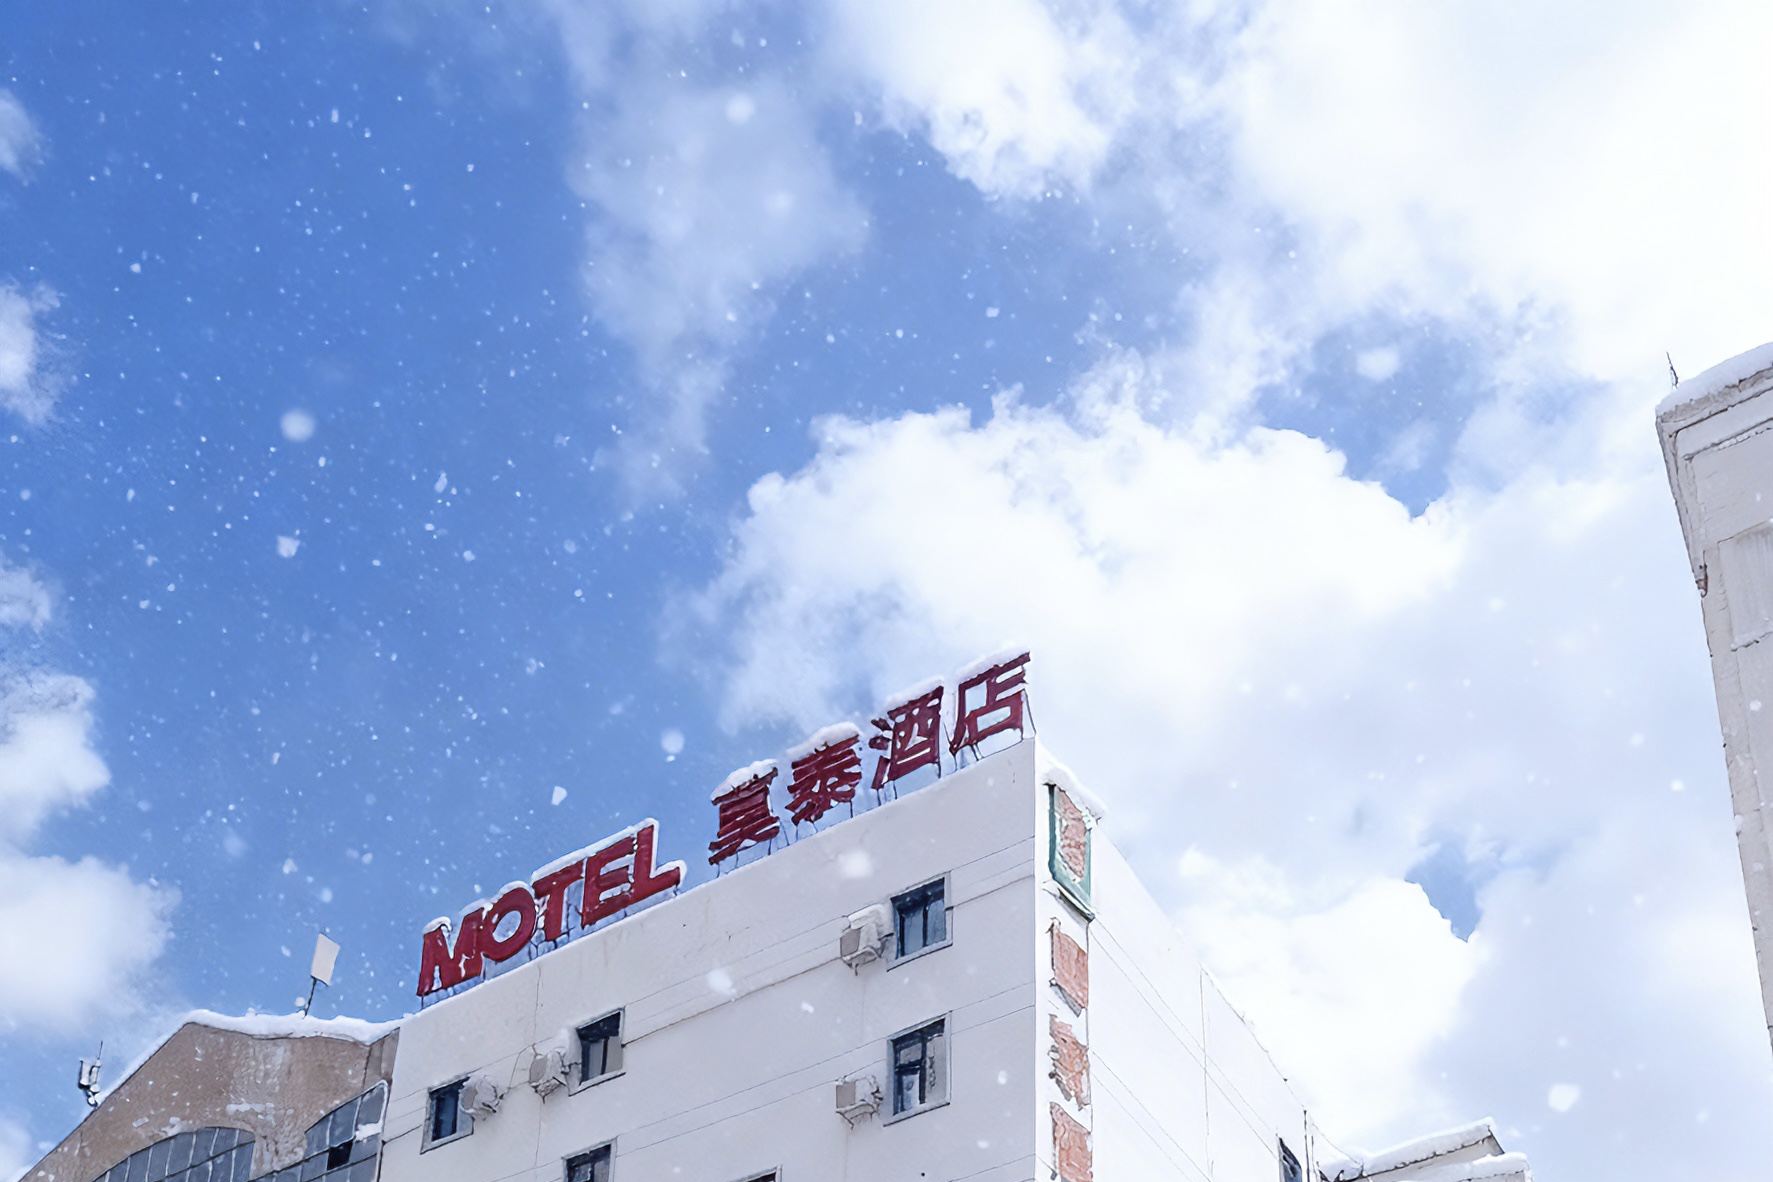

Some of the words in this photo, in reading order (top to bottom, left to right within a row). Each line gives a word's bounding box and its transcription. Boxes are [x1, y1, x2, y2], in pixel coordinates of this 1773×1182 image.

[707, 652, 1031, 864] 莫泰酒店
[417, 820, 682, 998] MOTEL
